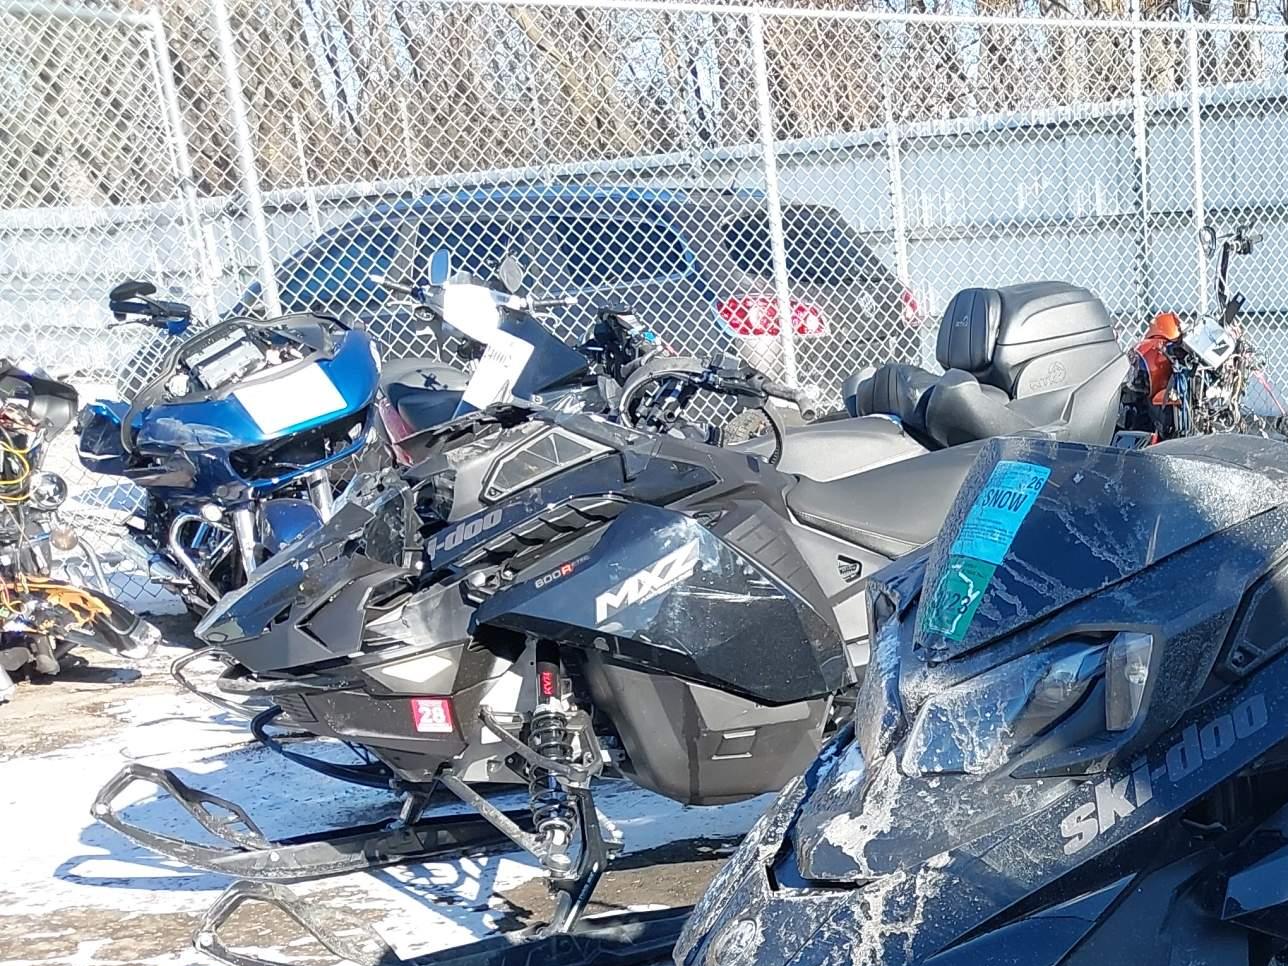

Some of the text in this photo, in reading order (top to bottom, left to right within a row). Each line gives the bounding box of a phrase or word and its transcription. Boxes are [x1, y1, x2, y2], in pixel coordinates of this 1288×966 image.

[1027, 476, 1044, 491] 26
[982, 489, 1029, 512] SNOW
[595, 537, 699, 624] MXZ
